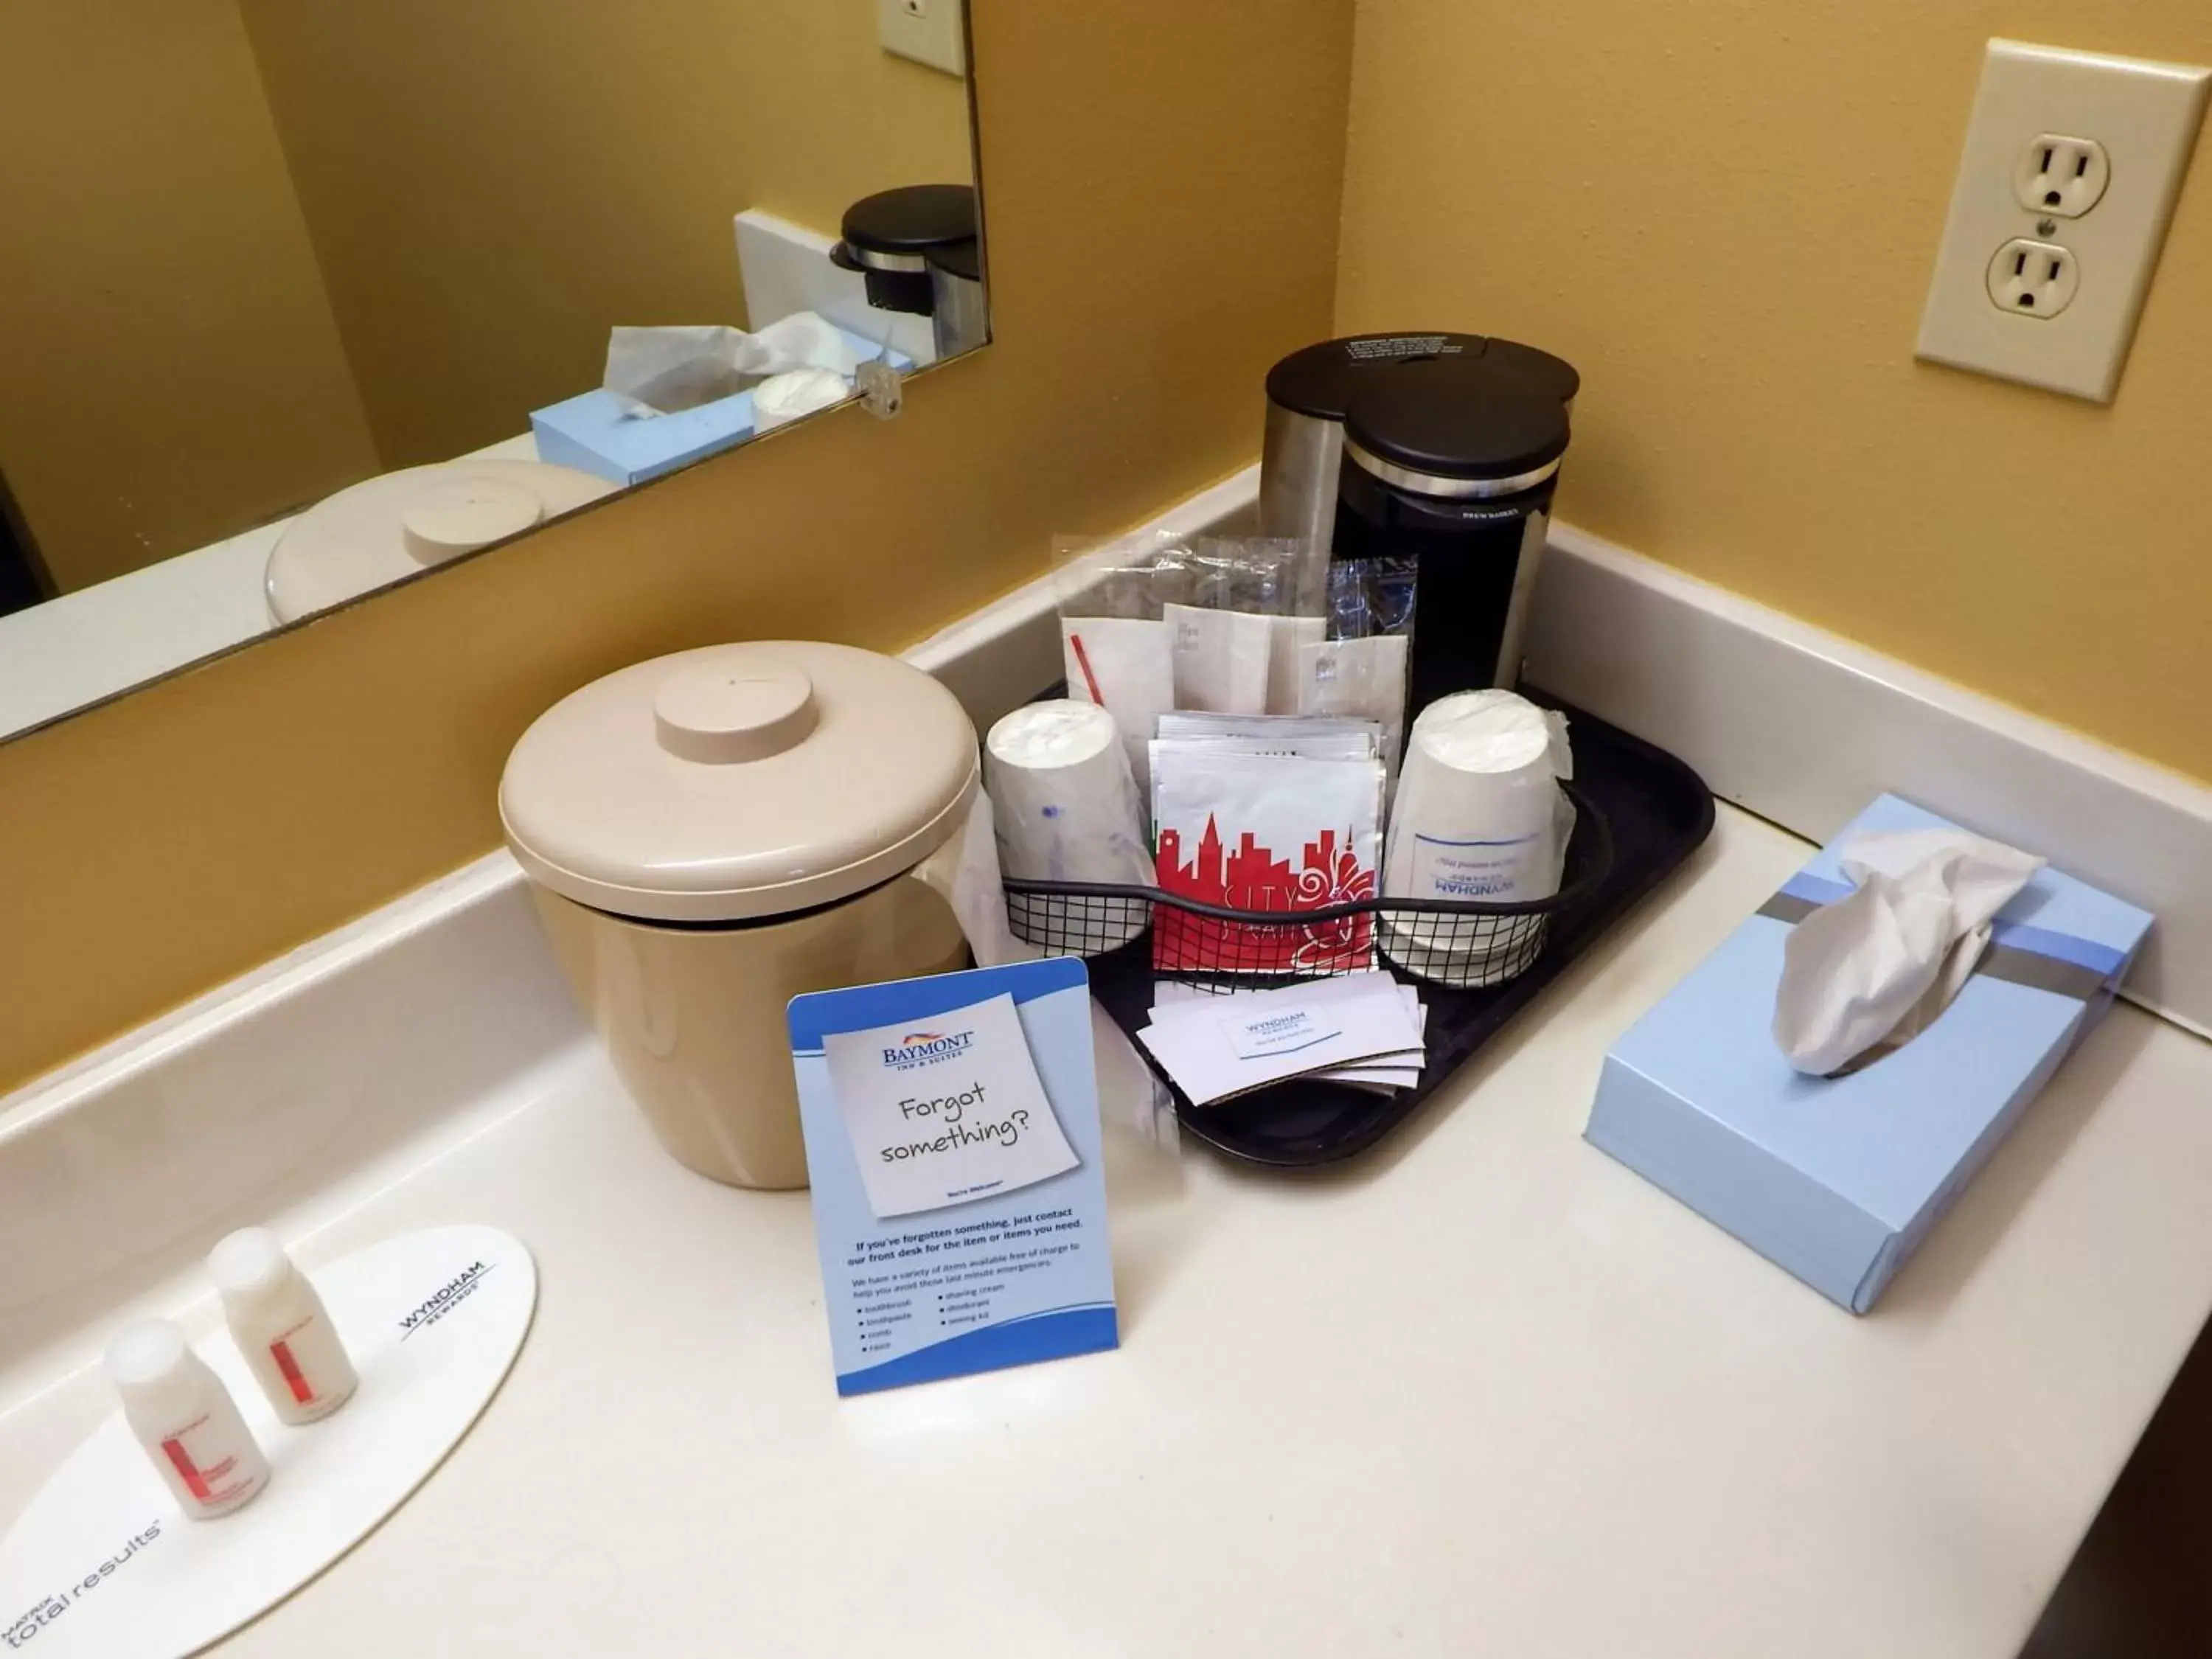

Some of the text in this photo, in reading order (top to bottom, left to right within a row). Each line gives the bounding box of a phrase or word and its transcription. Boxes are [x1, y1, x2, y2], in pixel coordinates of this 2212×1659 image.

[1225, 884, 1297, 911] CITY
[1435, 879, 1516, 895] WYNDHAM
[1245, 1011, 1306, 1032] WYNDHAM
[883, 1032, 974, 1063] BAYMONT
[898, 1082, 986, 1121] Forgot
[880, 1109, 1029, 1162] something?
[848, 1219, 1083, 1266] our front desk for the item or items you need.
[856, 1208, 1073, 1251] If you've forgotten something, just contact
[852, 1279, 866, 1287] We
[868, 1275, 888, 1284] have
[899, 1268, 930, 1279] variety
[931, 1265, 941, 1273] of
[943, 1262, 967, 1271] items
[970, 1254, 1007, 1267] available
[1009, 1250, 1026, 1260] free
[1029, 1248, 1037, 1256] of
[1039, 1243, 1068, 1256] charge
[1070, 1242, 1080, 1251] to
[853, 1289, 873, 1298] help
[875, 1287, 891, 1297] you
[894, 1282, 917, 1291] avoid
[919, 1279, 943, 1287] those
[945, 1274, 961, 1283] last
[964, 1269, 995, 1280] minute
[398, 1261, 484, 1327] WYNDHAM
[8, 1523, 161, 1648] total results
